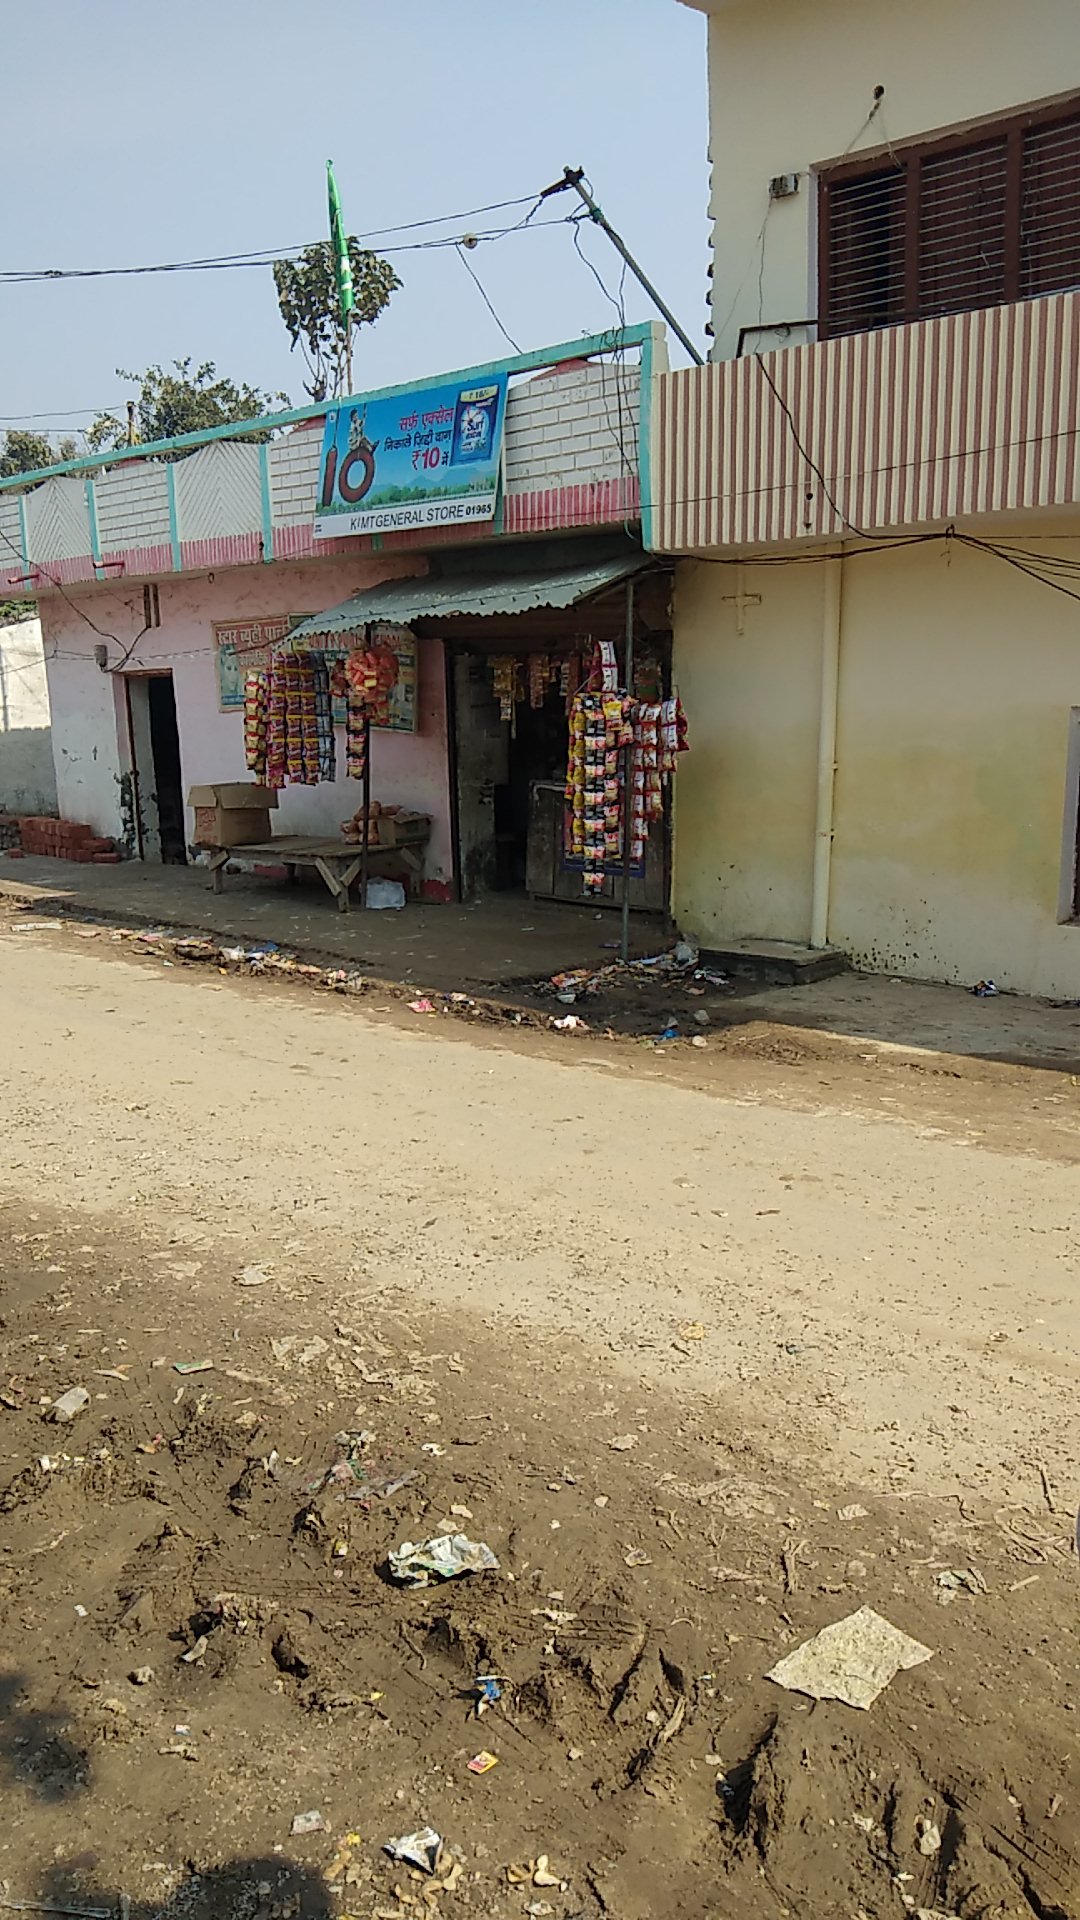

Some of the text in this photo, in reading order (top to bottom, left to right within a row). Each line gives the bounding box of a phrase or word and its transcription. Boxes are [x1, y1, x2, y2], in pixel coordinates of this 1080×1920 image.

[384, 433, 411, 451] निकाले
[441, 450, 450, 466] में
[426, 504, 465, 521] STORE
